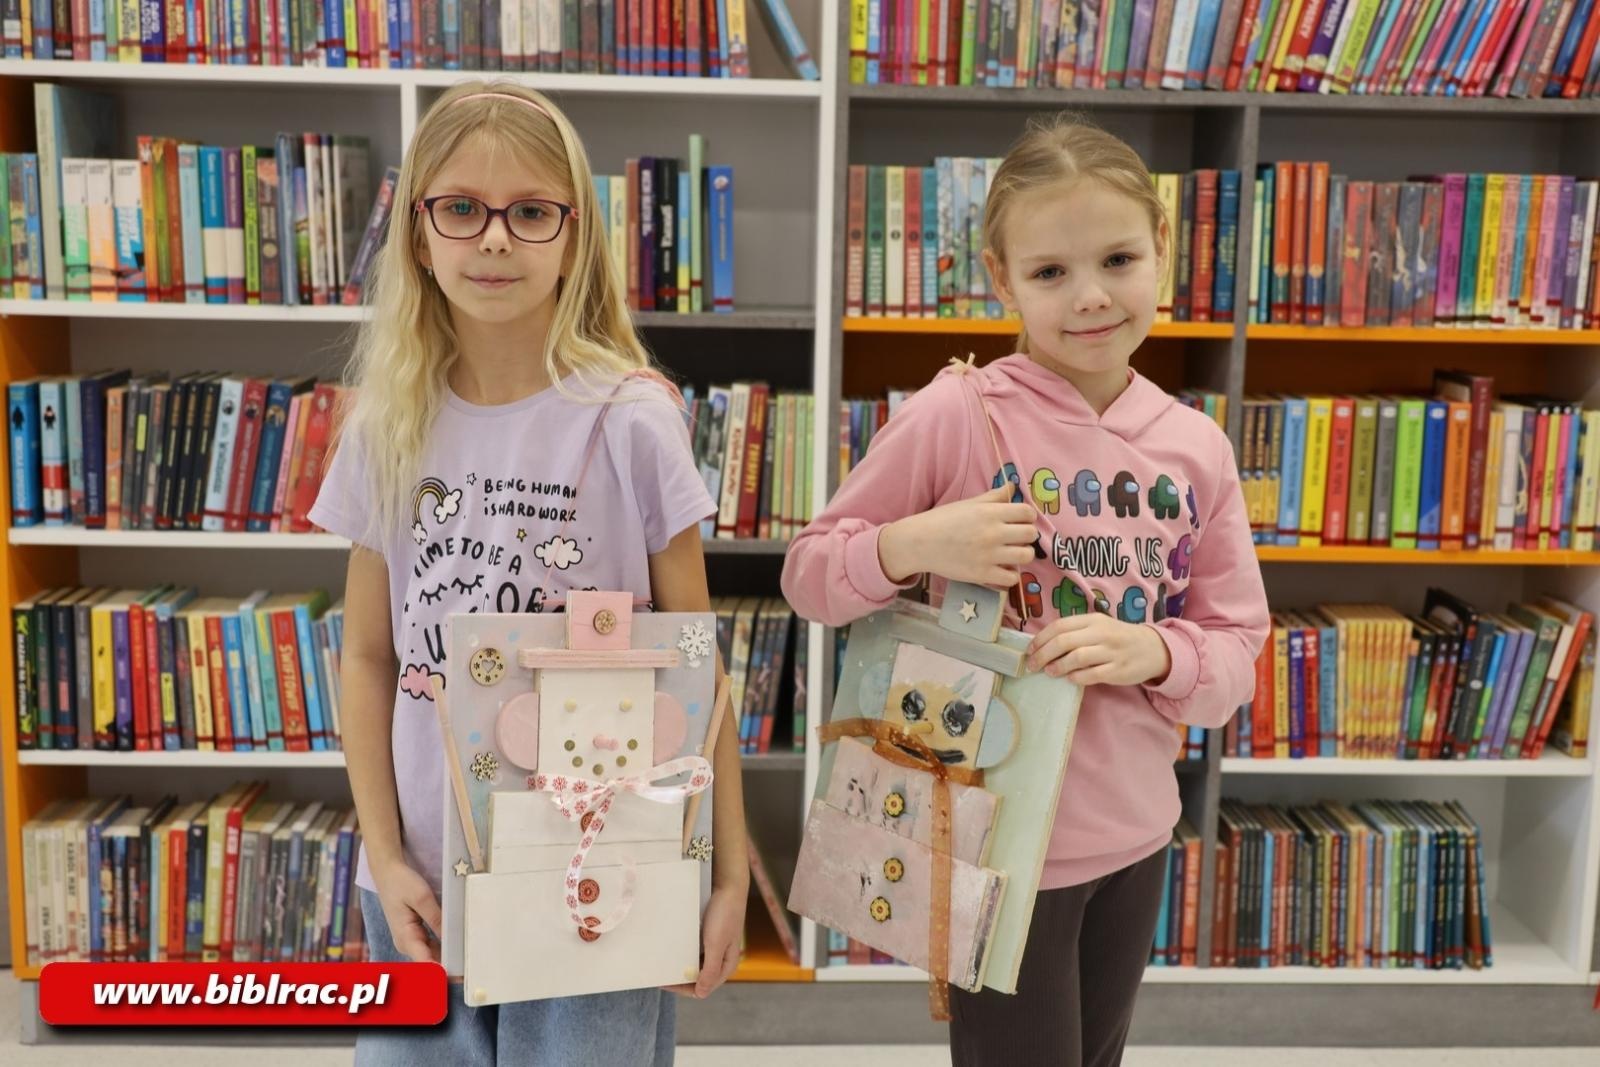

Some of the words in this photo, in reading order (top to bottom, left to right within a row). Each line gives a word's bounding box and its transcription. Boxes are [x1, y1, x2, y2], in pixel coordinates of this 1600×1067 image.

[484, 478, 526, 494] BEING
[531, 482, 577, 498] HUMAN
[539, 508, 577, 522] WORK
[461, 537, 484, 560] TO
[488, 544, 504, 567] BE
[508, 554, 522, 576] A
[1135, 537, 1164, 578] US
